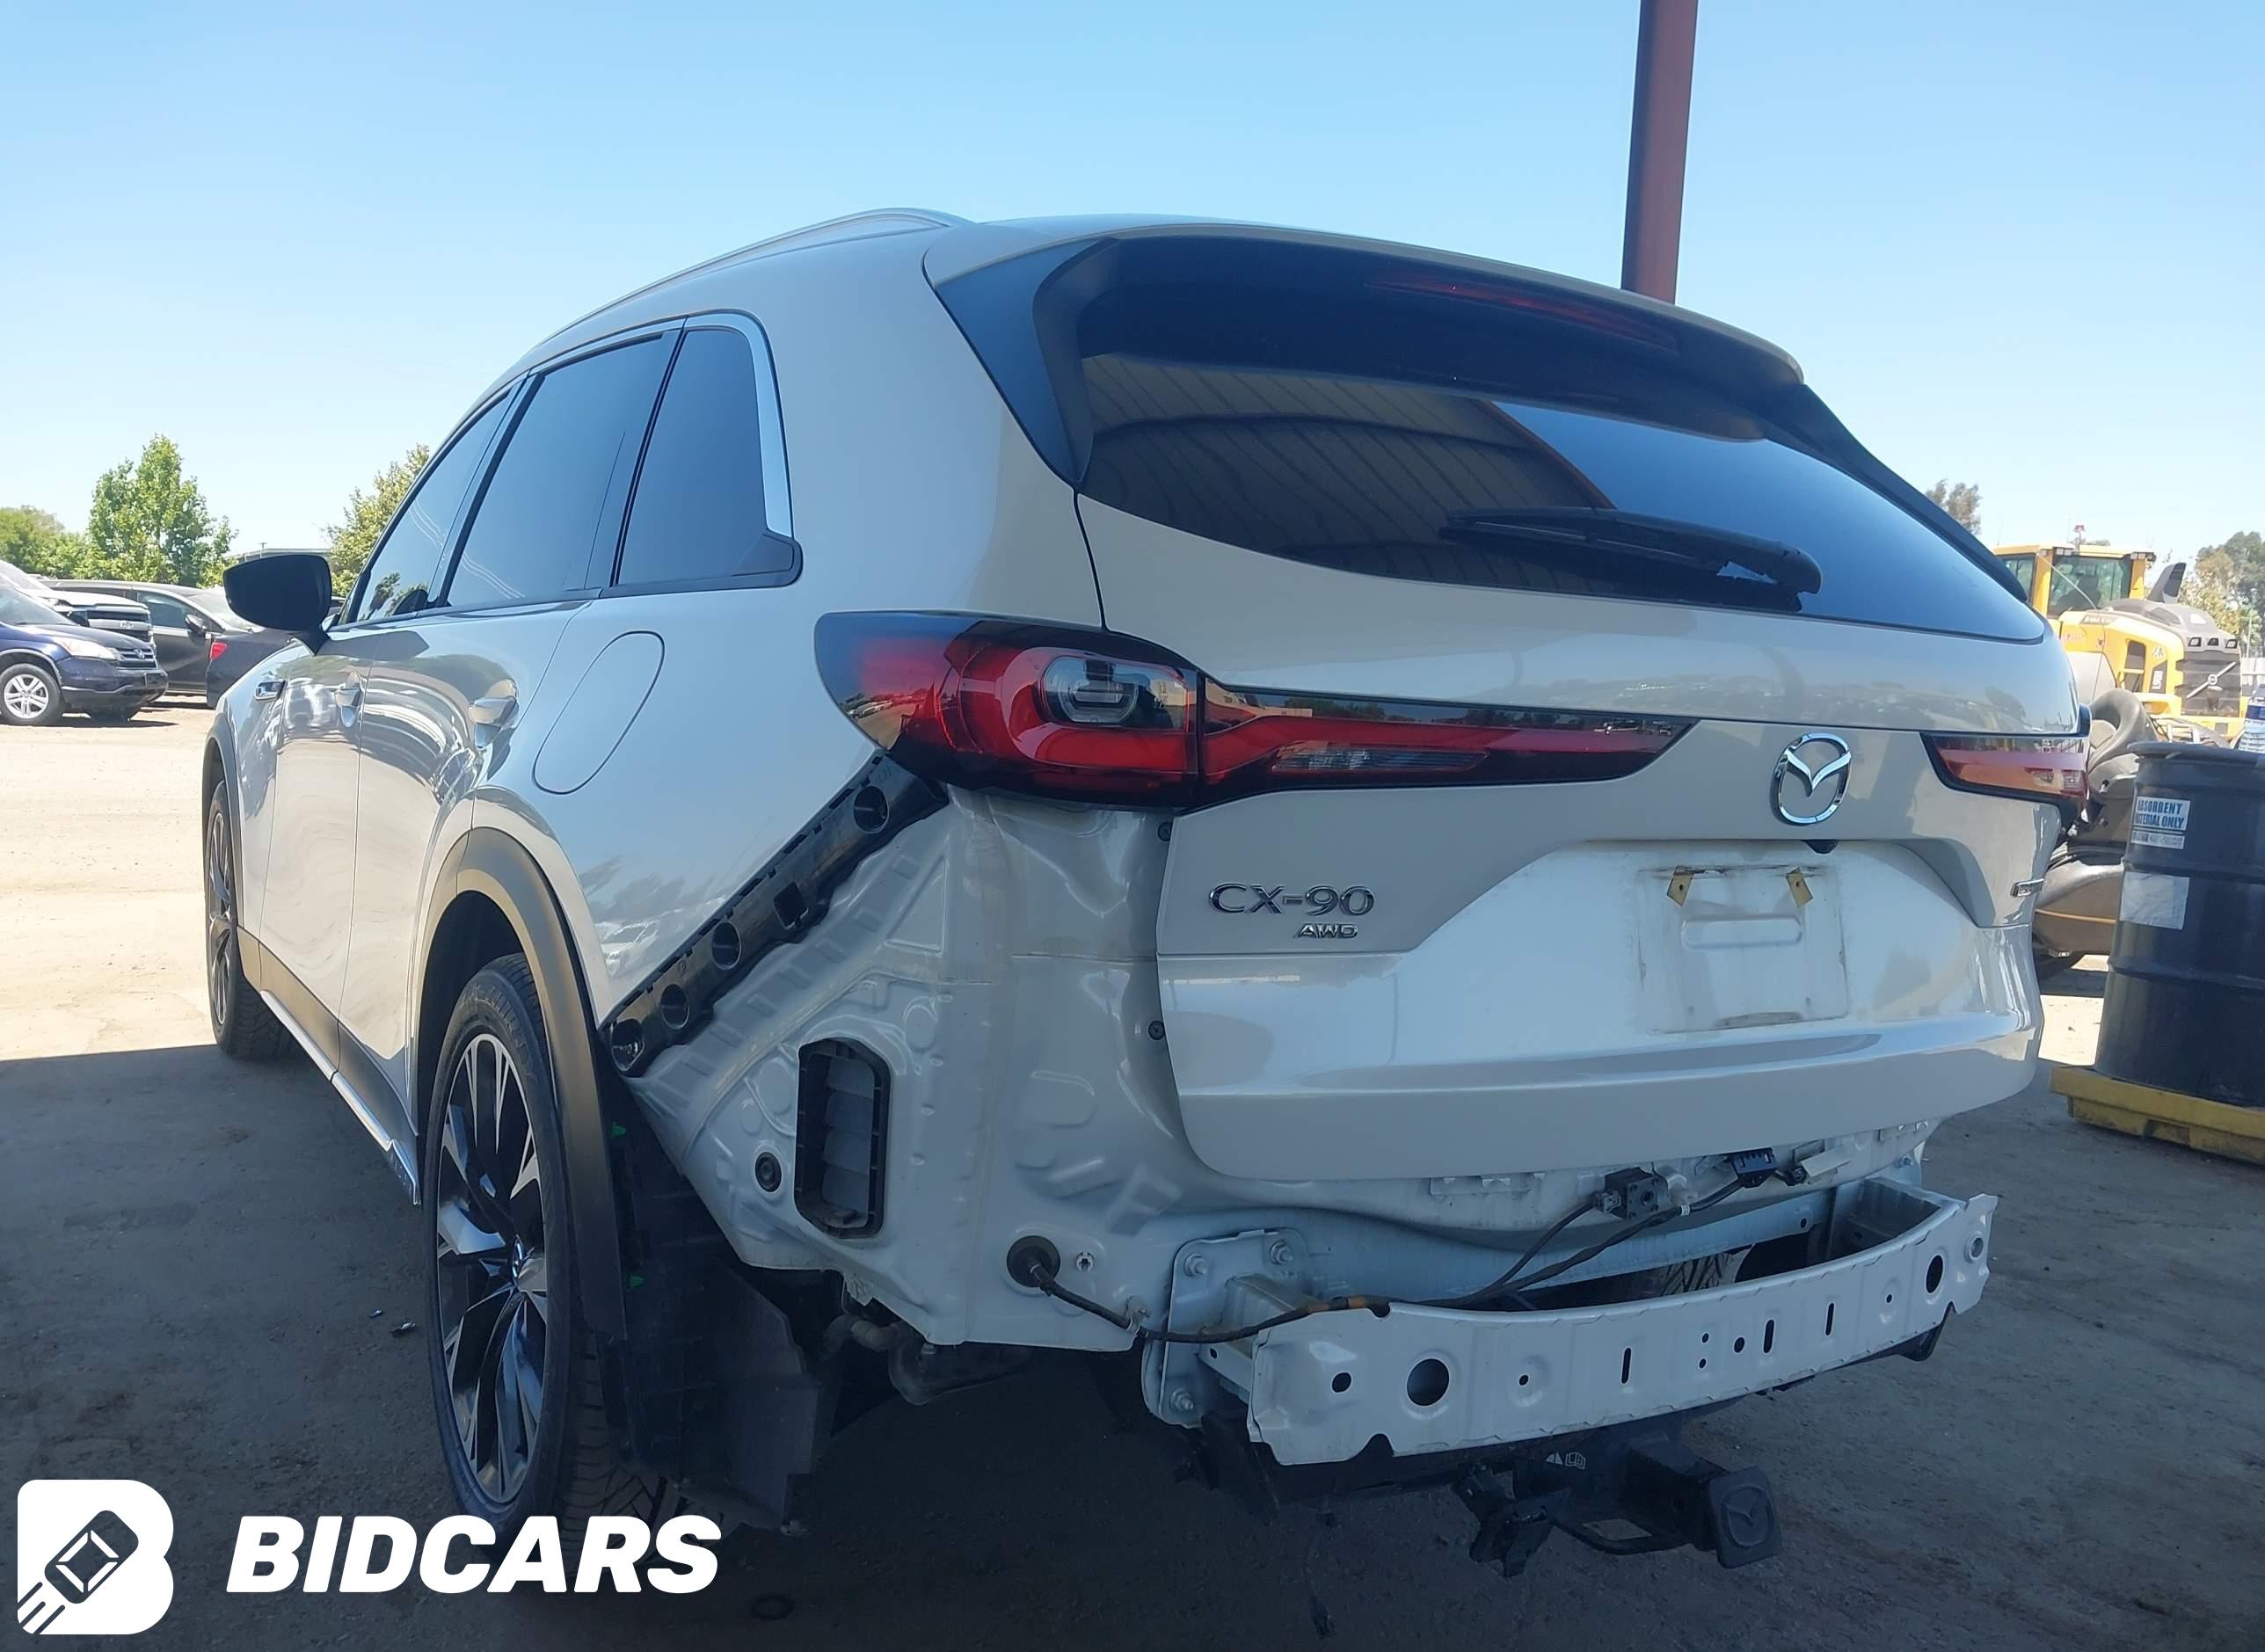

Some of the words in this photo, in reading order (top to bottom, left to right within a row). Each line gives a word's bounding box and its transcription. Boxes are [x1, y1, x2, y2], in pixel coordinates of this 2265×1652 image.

[2138, 800, 2182, 815] ABSORBENT
[2162, 816, 2184, 828] ONLY
[1209, 883, 1374, 916] CX-90
[1297, 923, 1358, 939] AWD
